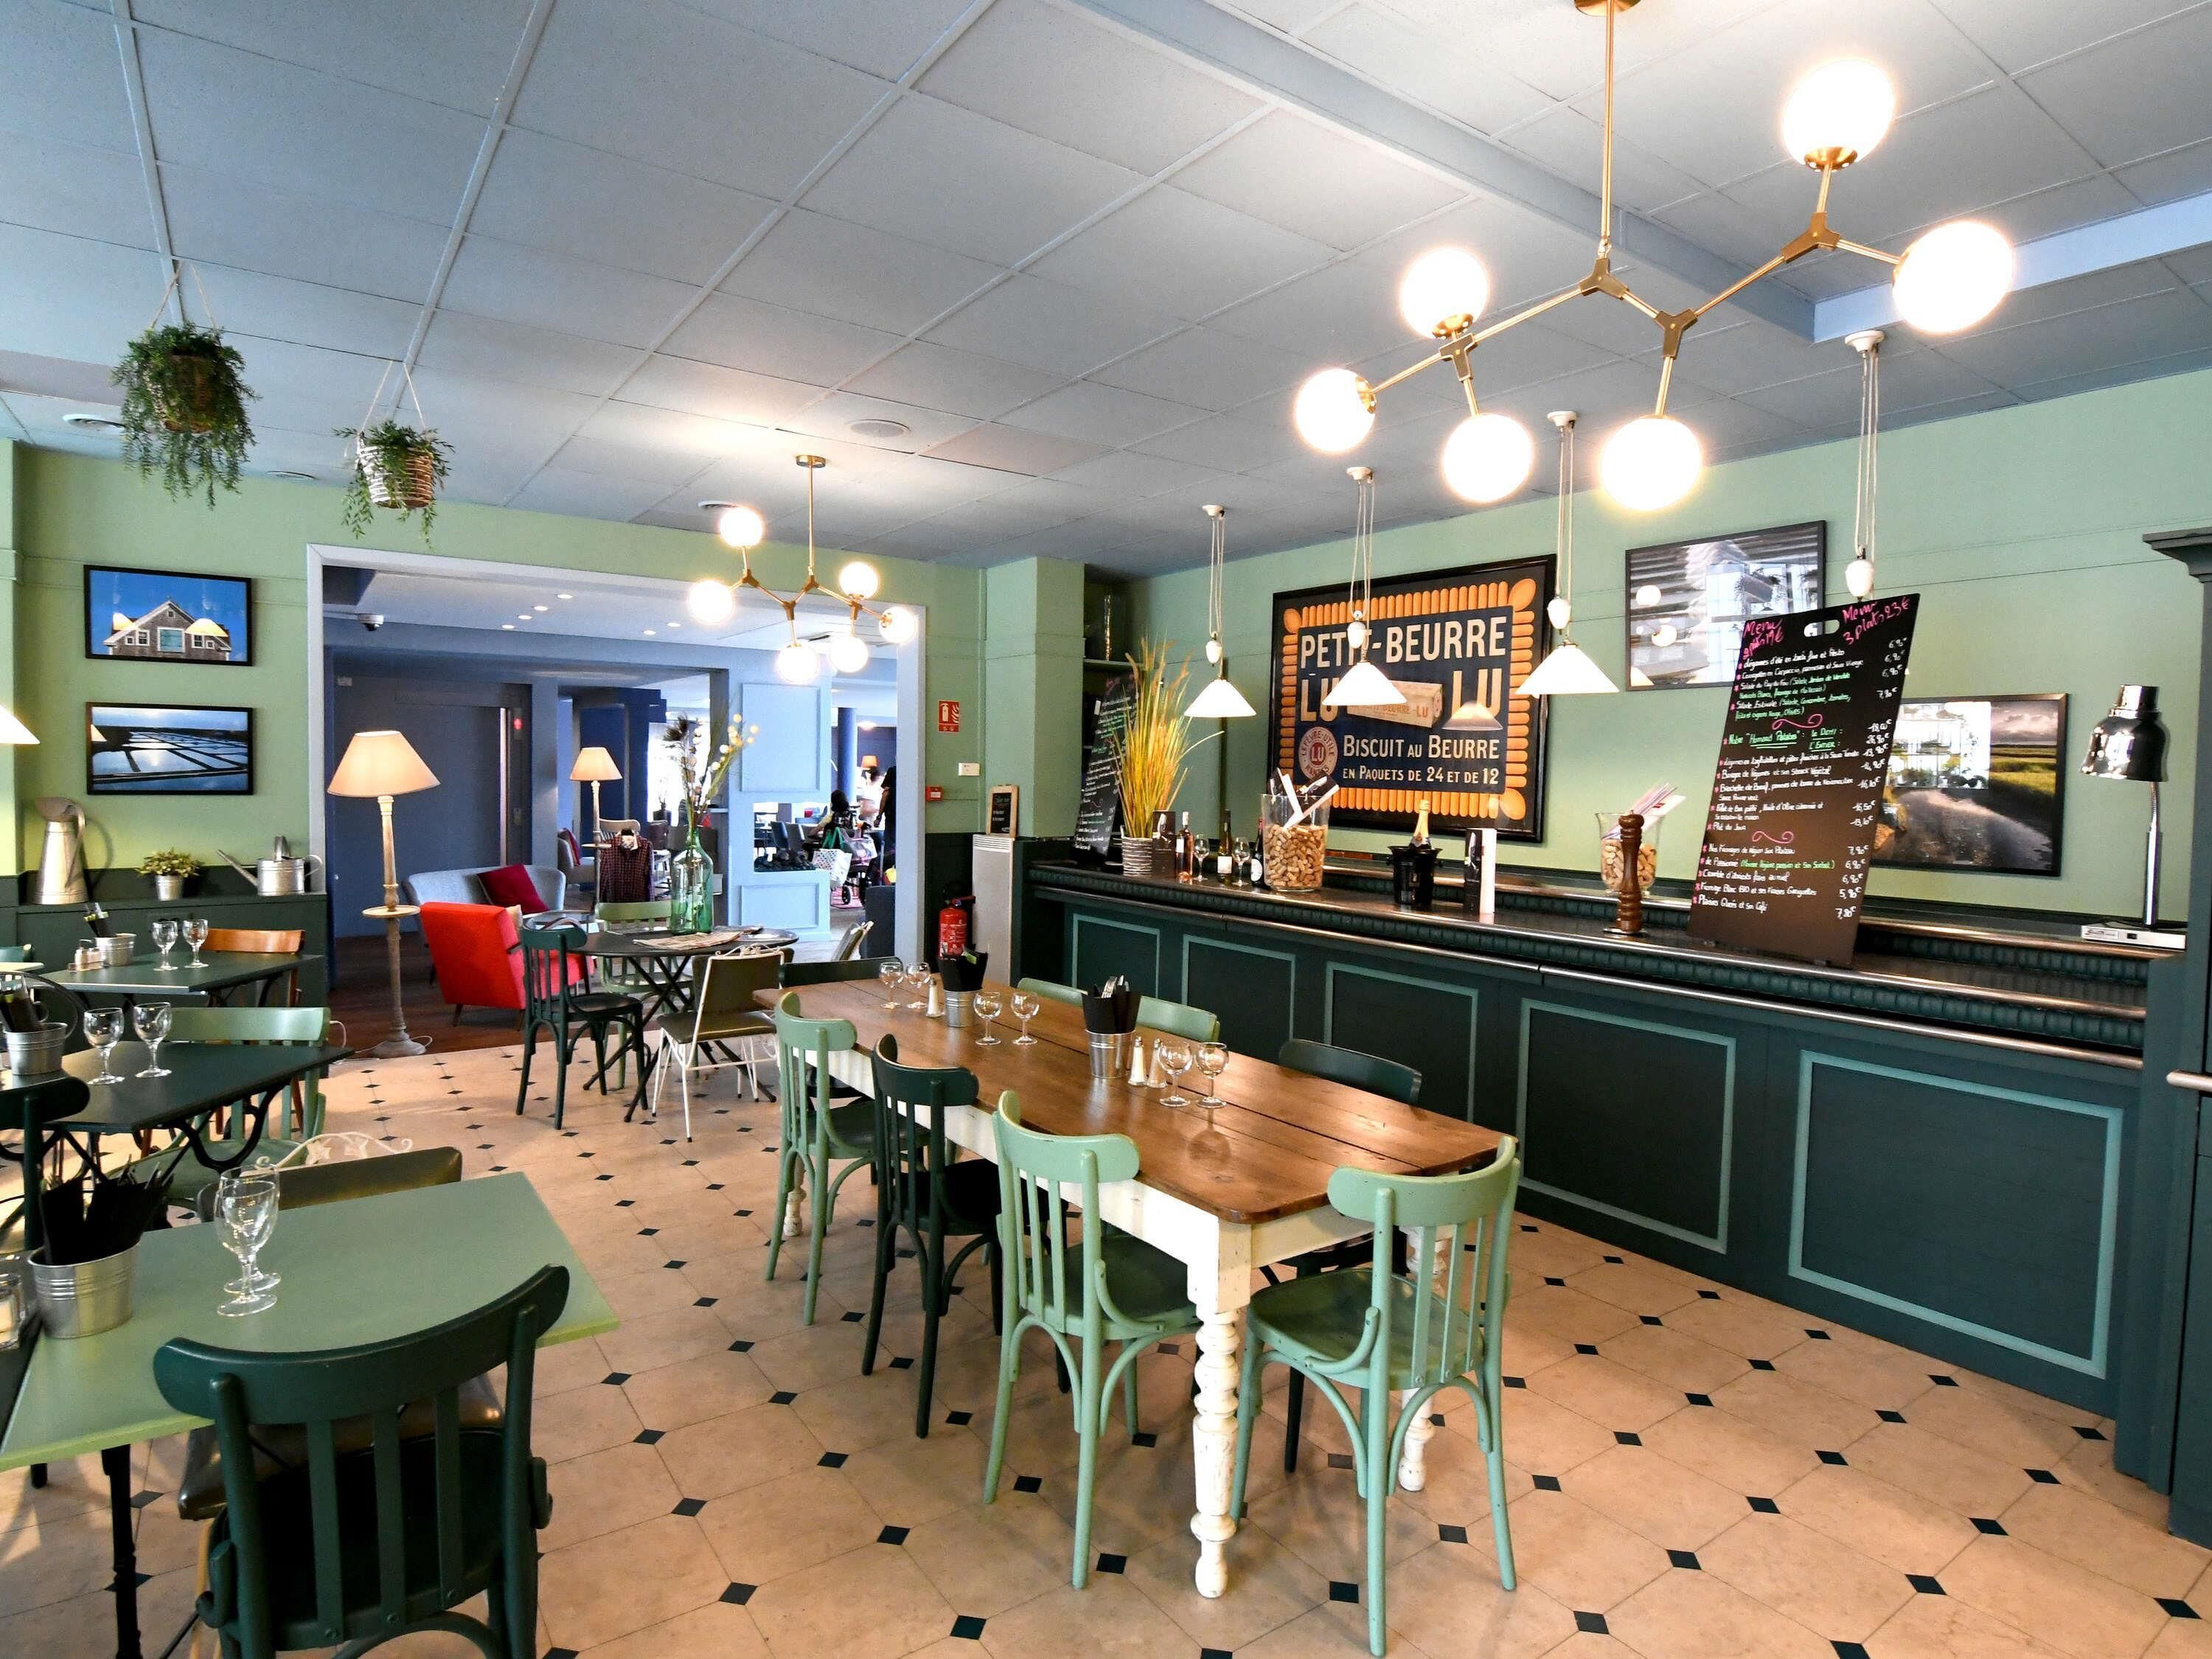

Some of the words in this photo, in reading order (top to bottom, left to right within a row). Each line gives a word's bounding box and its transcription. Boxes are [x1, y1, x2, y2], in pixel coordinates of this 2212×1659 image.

[1843, 602, 1878, 623] Menu
[1743, 619, 1783, 638] Menu
[1843, 631, 1854, 645] 3
[1300, 677, 1340, 722] LU
[1451, 667, 1503, 721] LU
[1311, 745, 1325, 762] LU
[1426, 766, 1444, 783] 24
[1447, 771, 1461, 784] ET
[1464, 771, 1479, 785] DE
[1483, 768, 1500, 785] 12
